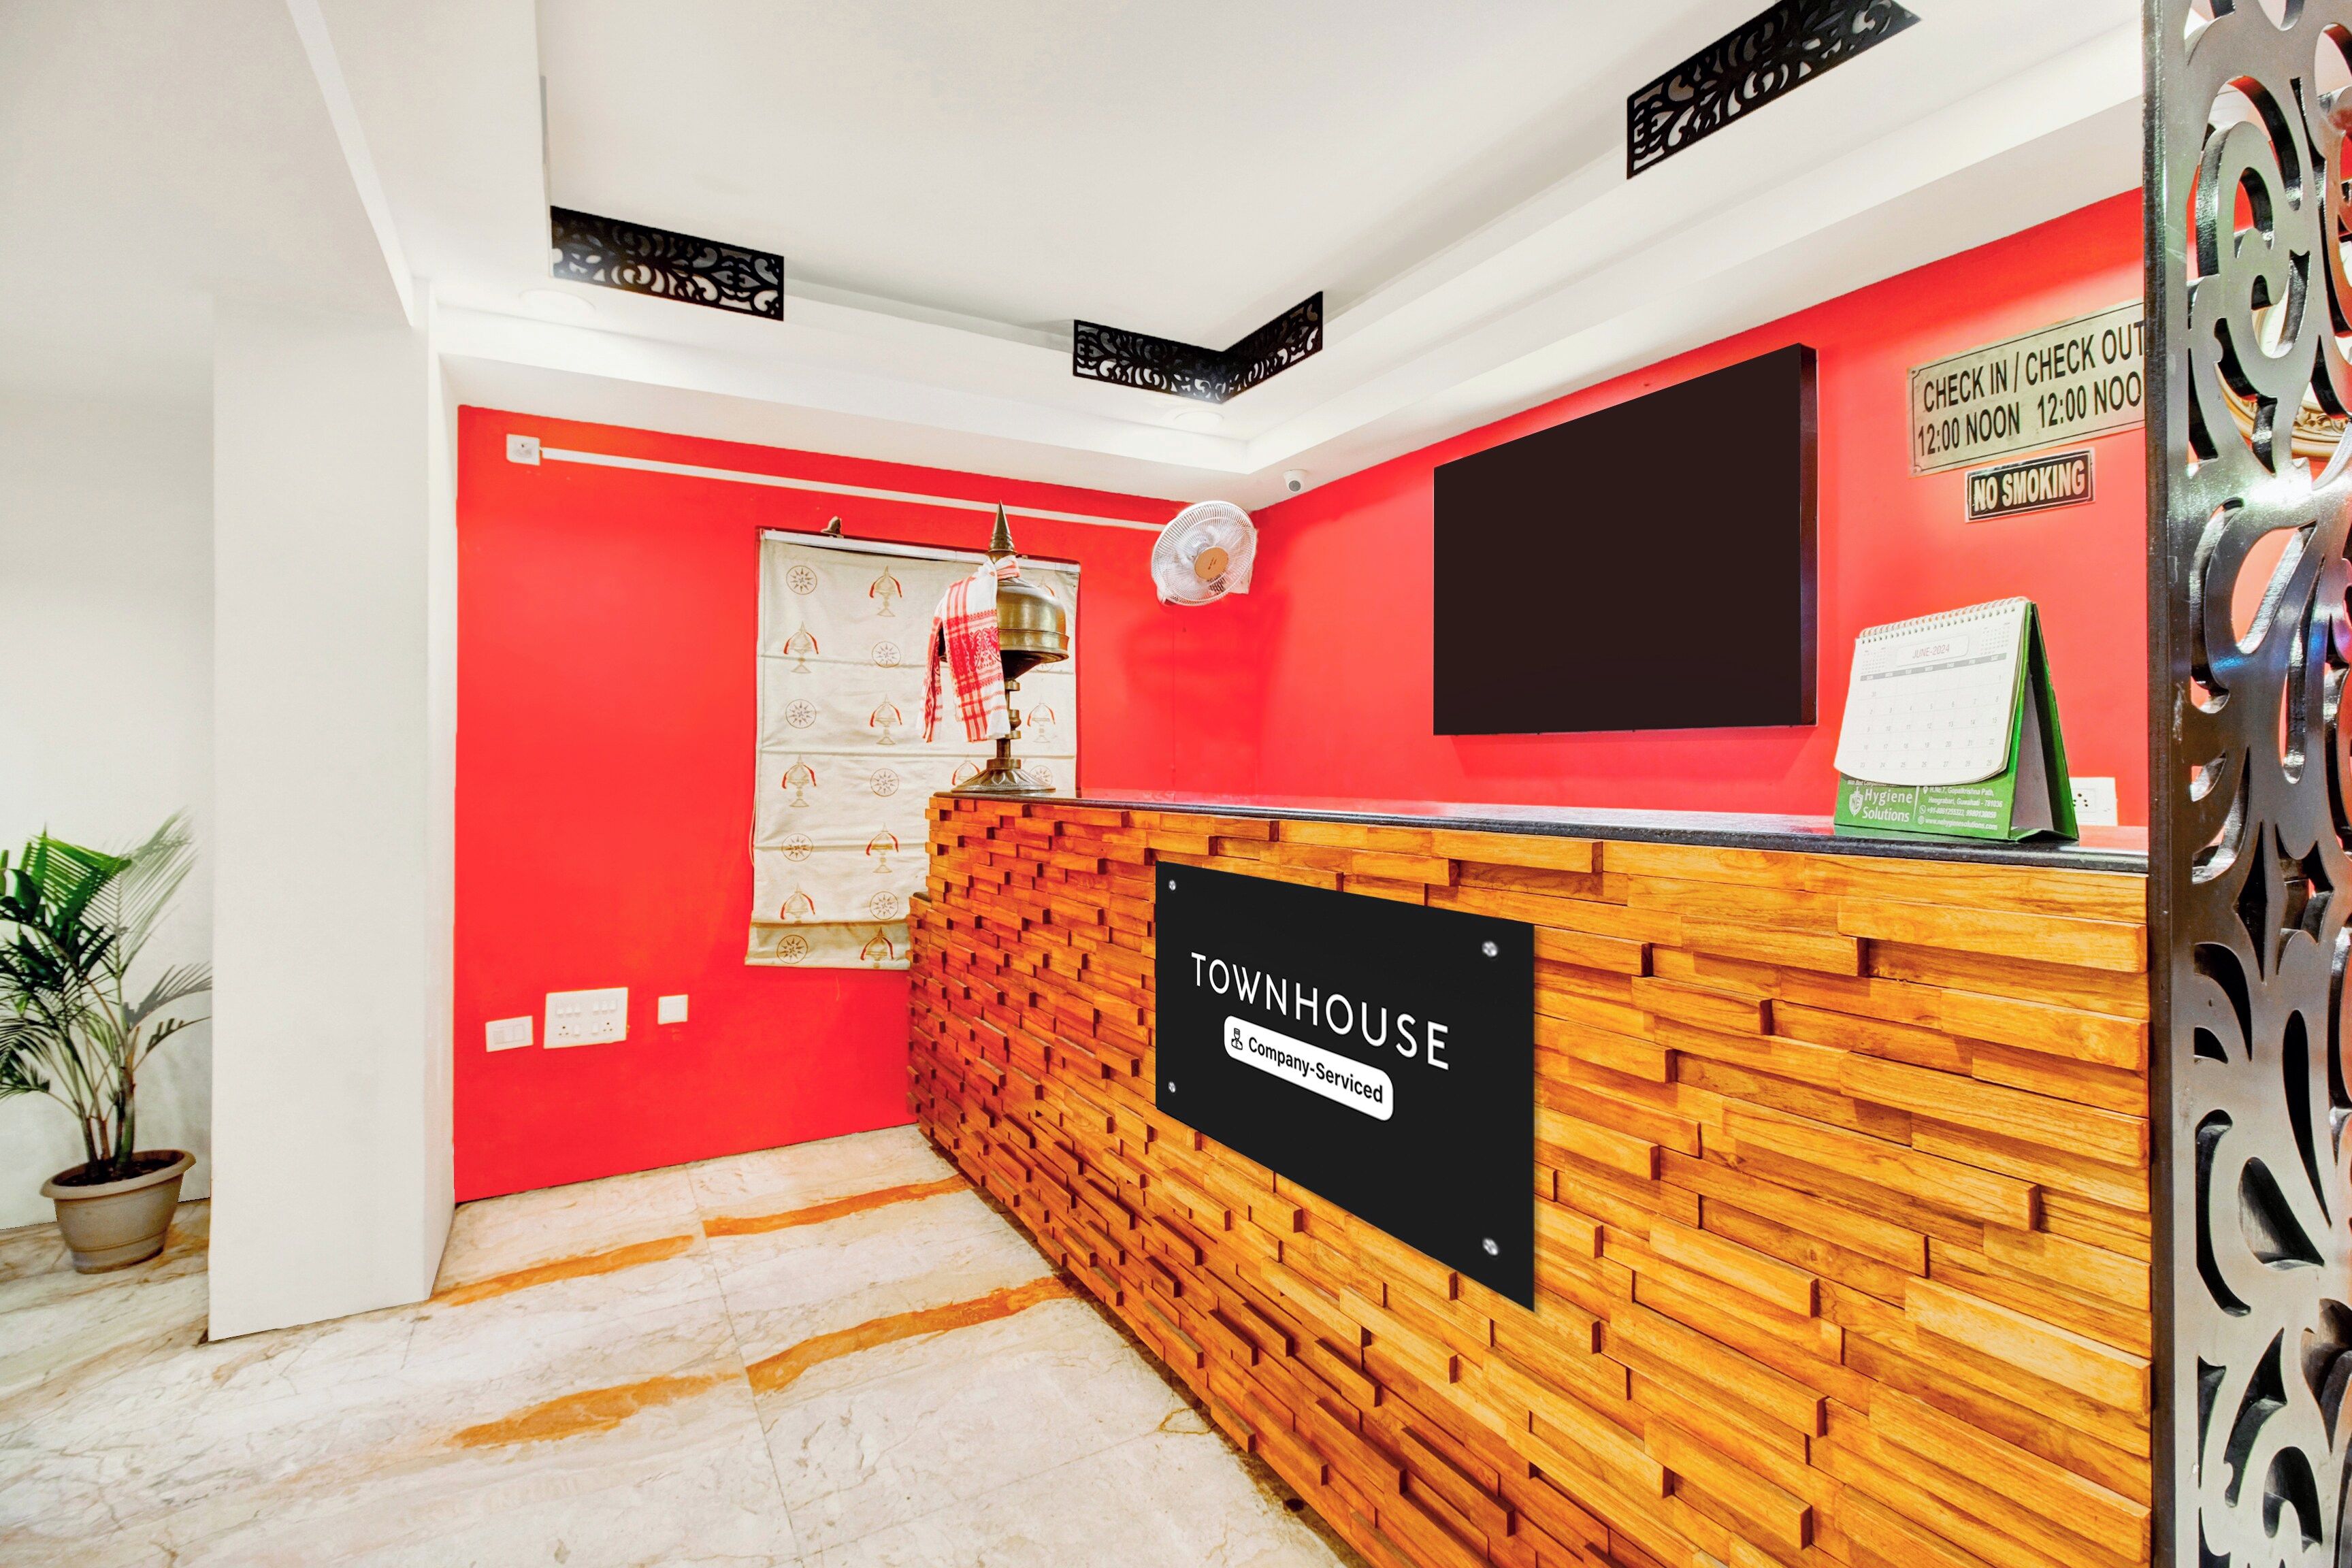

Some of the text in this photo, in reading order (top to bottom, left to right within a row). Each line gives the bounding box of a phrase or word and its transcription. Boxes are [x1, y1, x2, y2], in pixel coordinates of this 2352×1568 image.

[1923, 365, 1985, 412] CHECK
[1990, 359, 2008, 395] IN
[2025, 334, 2096, 386] CHECK
[2102, 320, 2144, 365] OUT
[1918, 371, 2144, 457] 12:00 NOON 12:00 NOO
[1974, 459, 2085, 512] NO SMOKING
[1912, 644, 1950, 659] JUNE-2024
[1862, 806, 1910, 822] Solutions
[1864, 788, 1913, 806] Hygiene
[1191, 952, 1449, 1070] TOWNHOUSE
[1248, 1036, 1383, 1104] Company-Serviced
